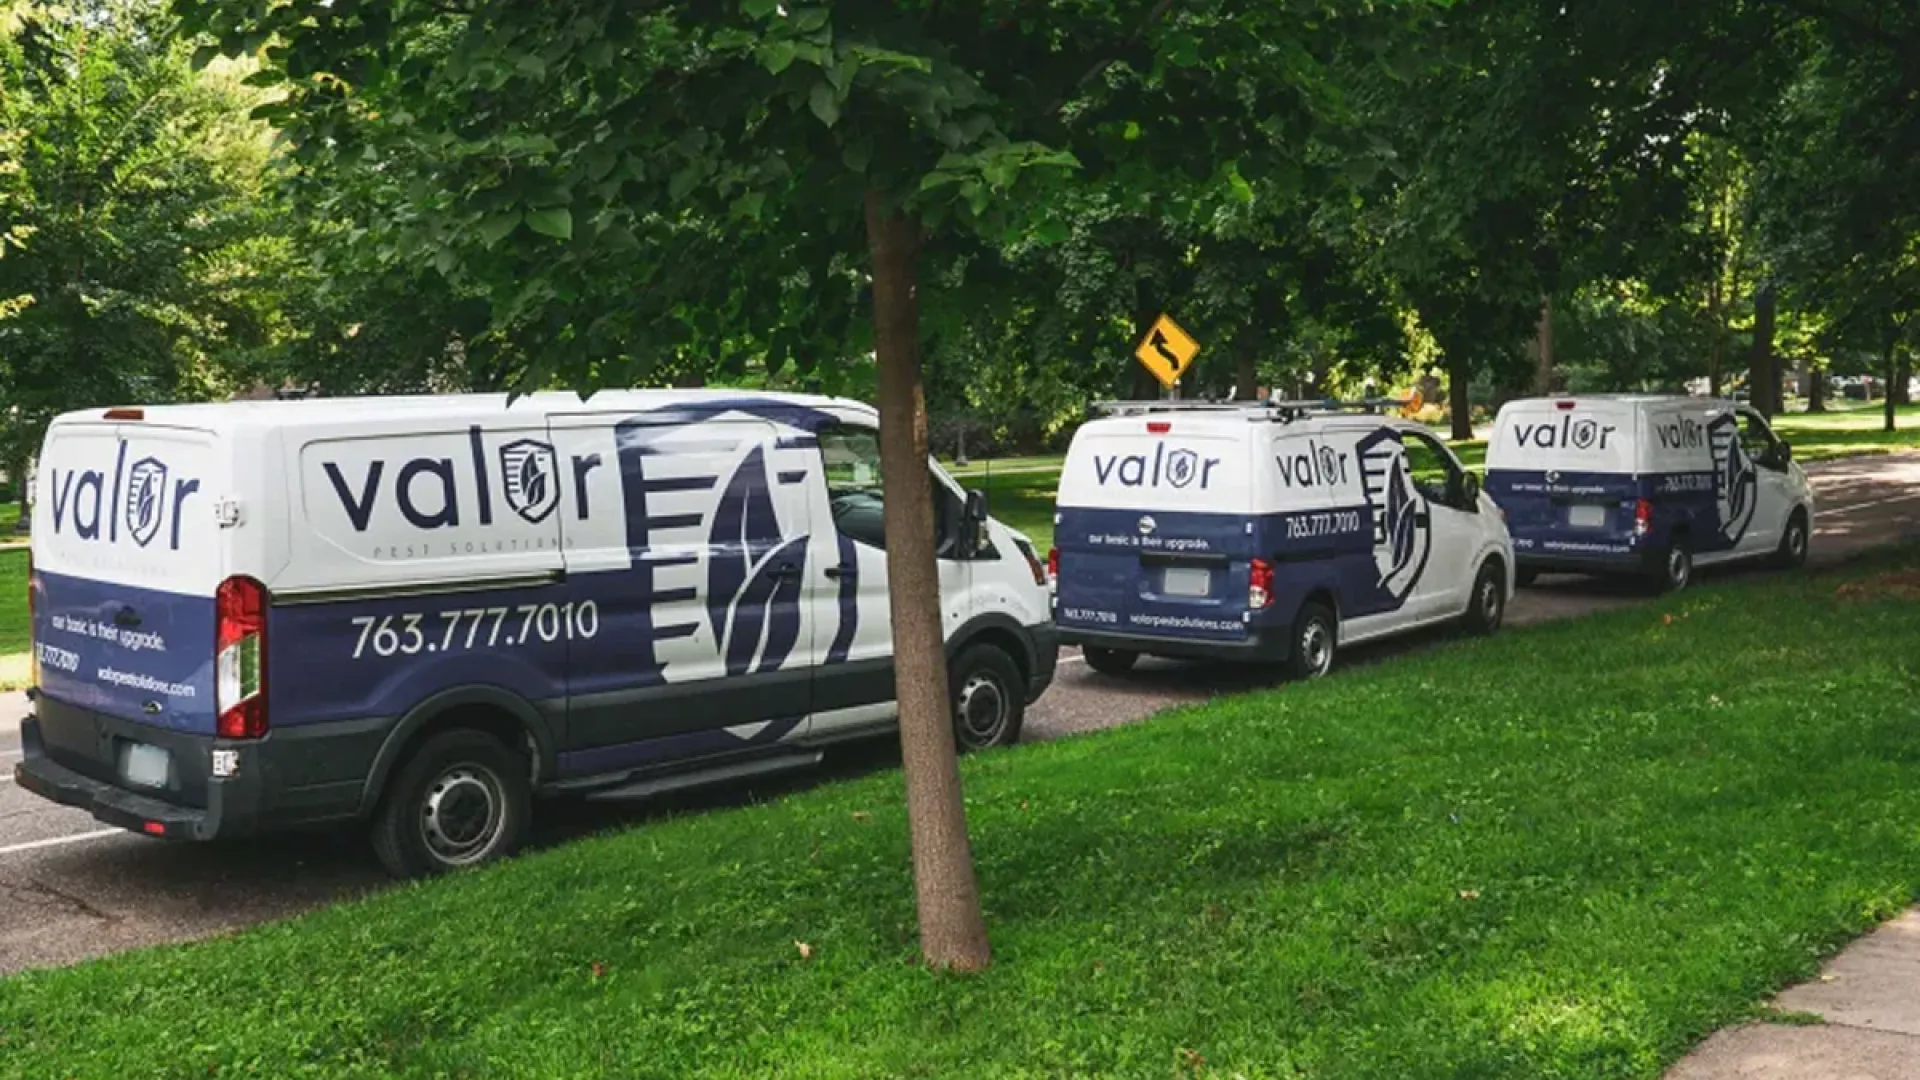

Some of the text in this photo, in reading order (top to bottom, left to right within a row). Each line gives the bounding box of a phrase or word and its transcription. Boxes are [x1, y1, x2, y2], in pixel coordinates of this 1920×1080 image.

[1514, 415, 1616, 449] valor
[322, 425, 602, 531] valor
[1094, 441, 1219, 488] valor
[1276, 438, 1348, 488] valor
[51, 439, 200, 550] valor
[1285, 510, 1360, 539] 763.777.7010
[374, 543, 430, 559] PEST
[351, 600, 599, 659] 763.777.7010
